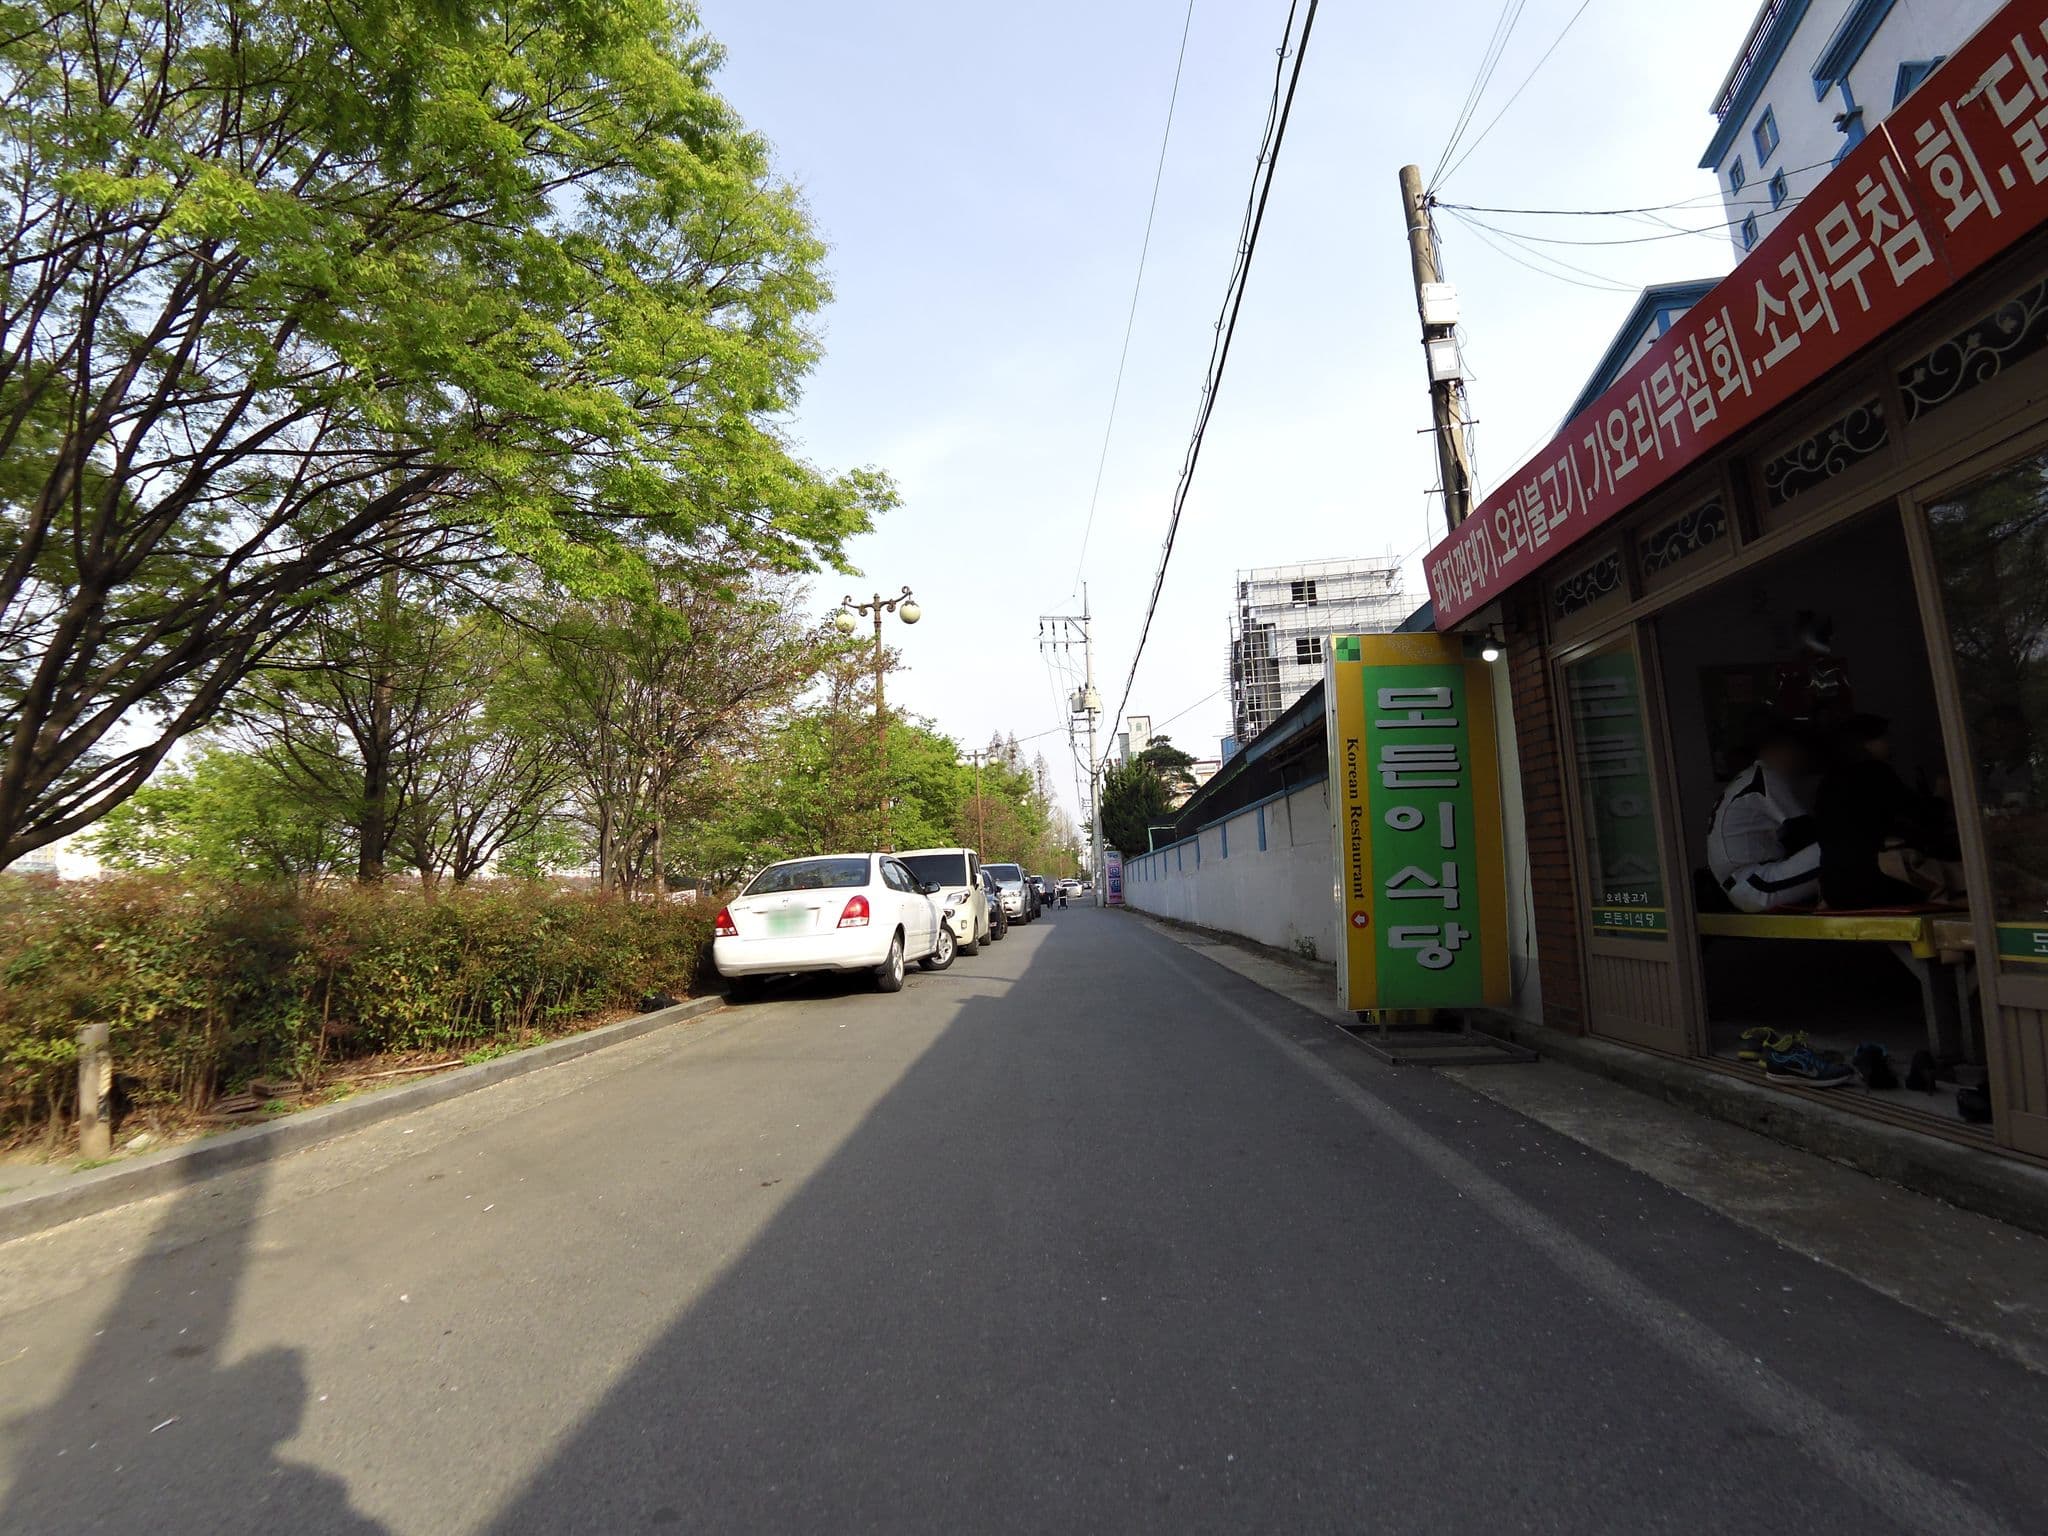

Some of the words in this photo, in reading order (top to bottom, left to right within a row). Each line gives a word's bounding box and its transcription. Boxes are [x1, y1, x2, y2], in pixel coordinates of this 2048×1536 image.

[1346, 738, 1359, 800] Korean
[1350, 805, 1365, 900] Restaurant
[1375, 686, 1470, 970] 모든이식당
